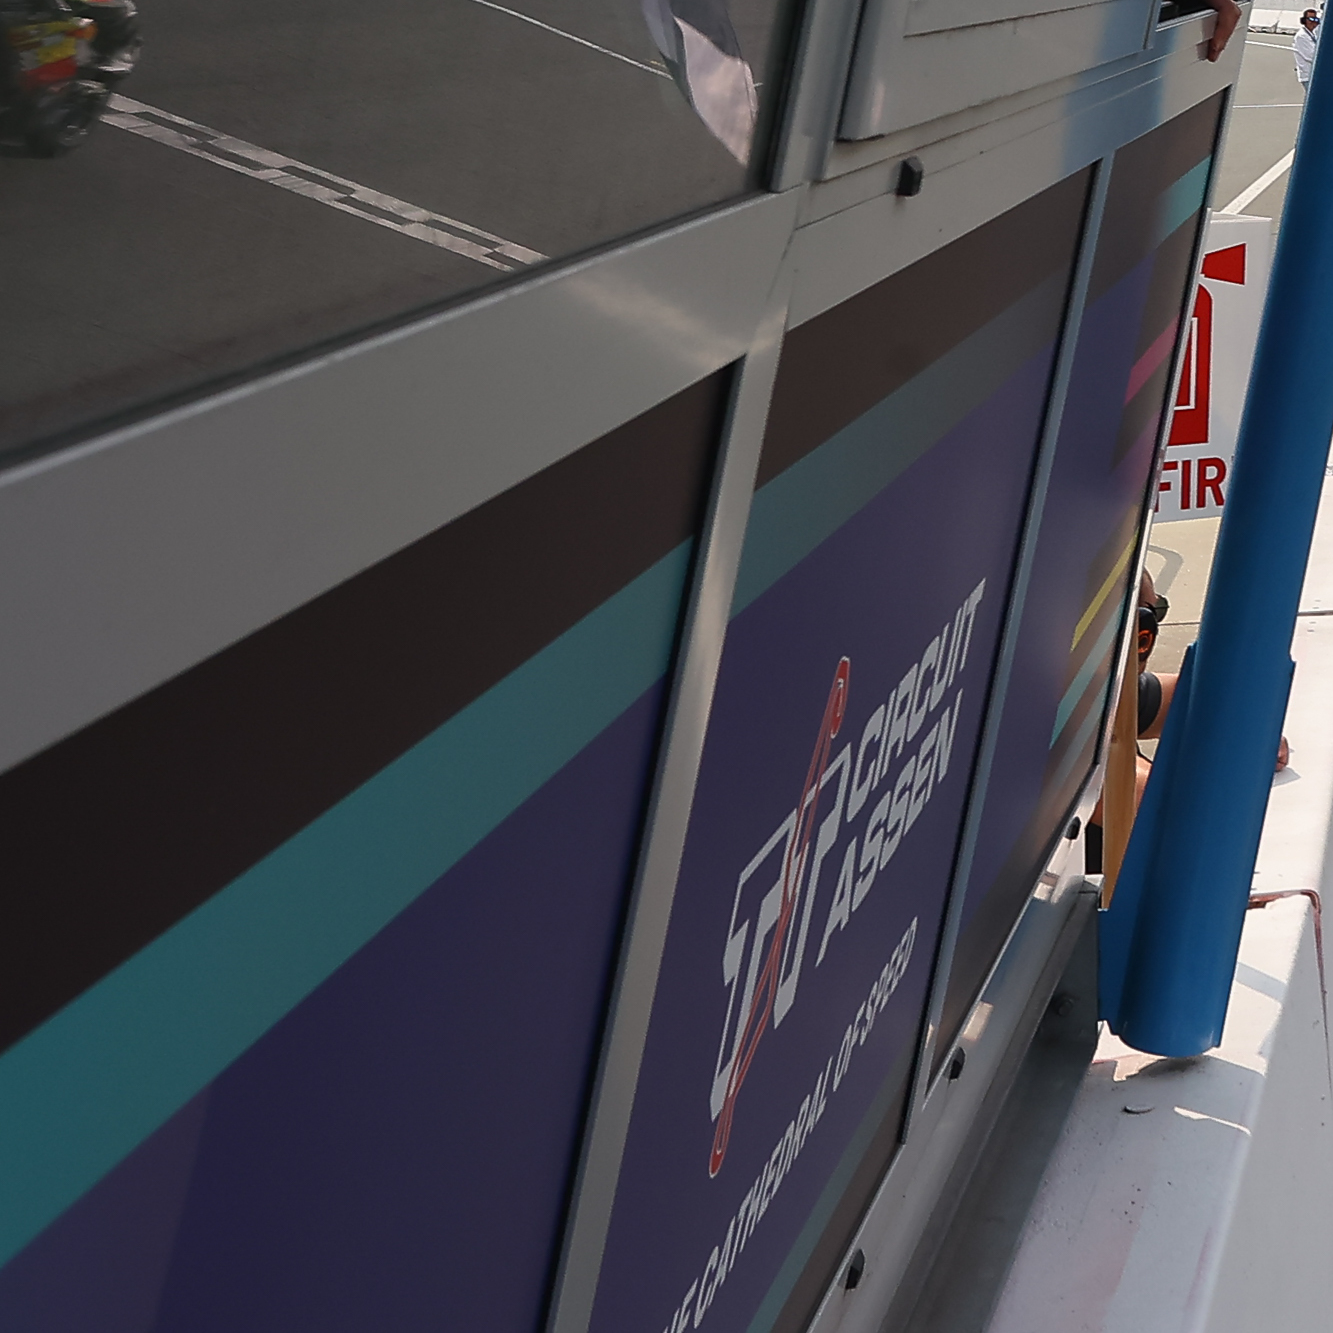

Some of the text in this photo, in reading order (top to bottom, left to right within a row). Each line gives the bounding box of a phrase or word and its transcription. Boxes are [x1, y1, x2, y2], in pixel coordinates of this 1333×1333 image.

[1154, 456, 1233, 513] FIR
[816, 688, 963, 968] ASSEN
[847, 577, 986, 823] CIRCUIT
[694, 916, 918, 1330] CATHEDRAL OF SPEED
